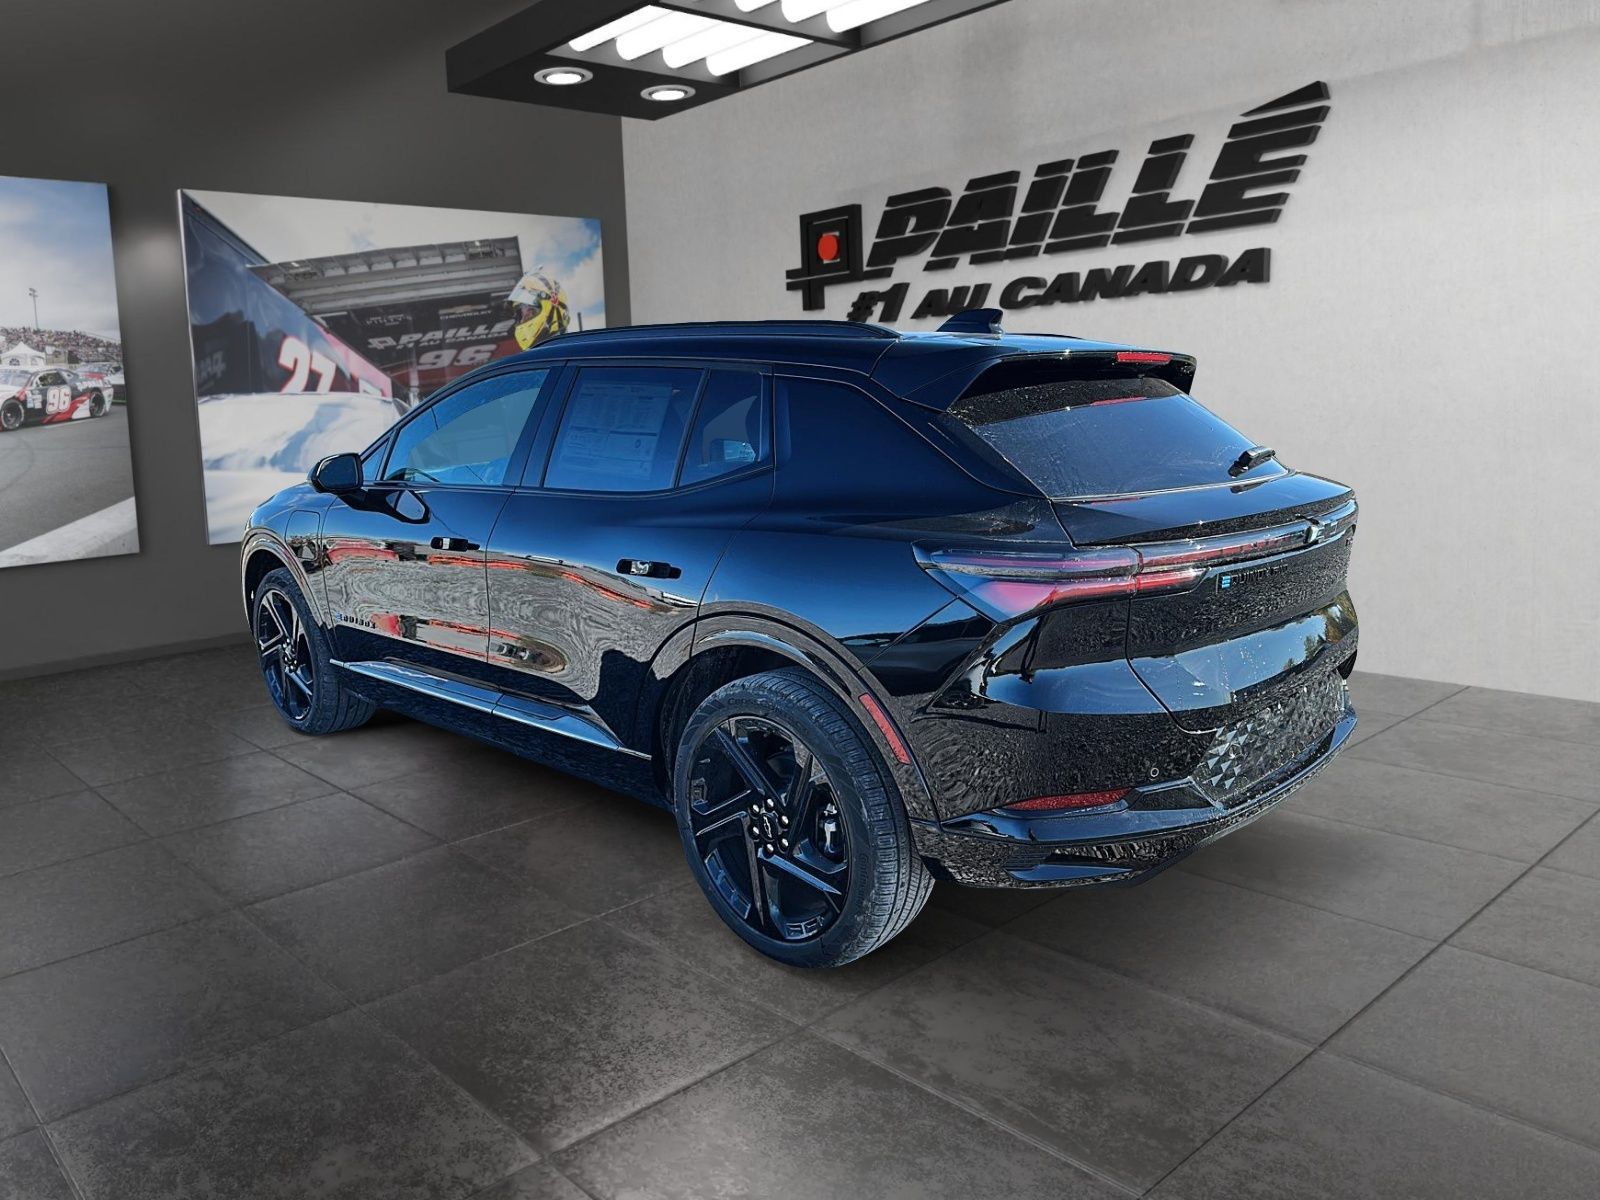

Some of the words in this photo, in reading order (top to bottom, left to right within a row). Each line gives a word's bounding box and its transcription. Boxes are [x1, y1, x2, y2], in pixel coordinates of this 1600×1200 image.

[863, 80, 1331, 273] PAILLÉ
[847, 282, 909, 323] #1
[911, 282, 991, 319] AU
[999, 247, 1271, 310] CANADA
[278, 335, 337, 395] 27
[417, 344, 497, 370] 96
[46, 385, 71, 414] 96
